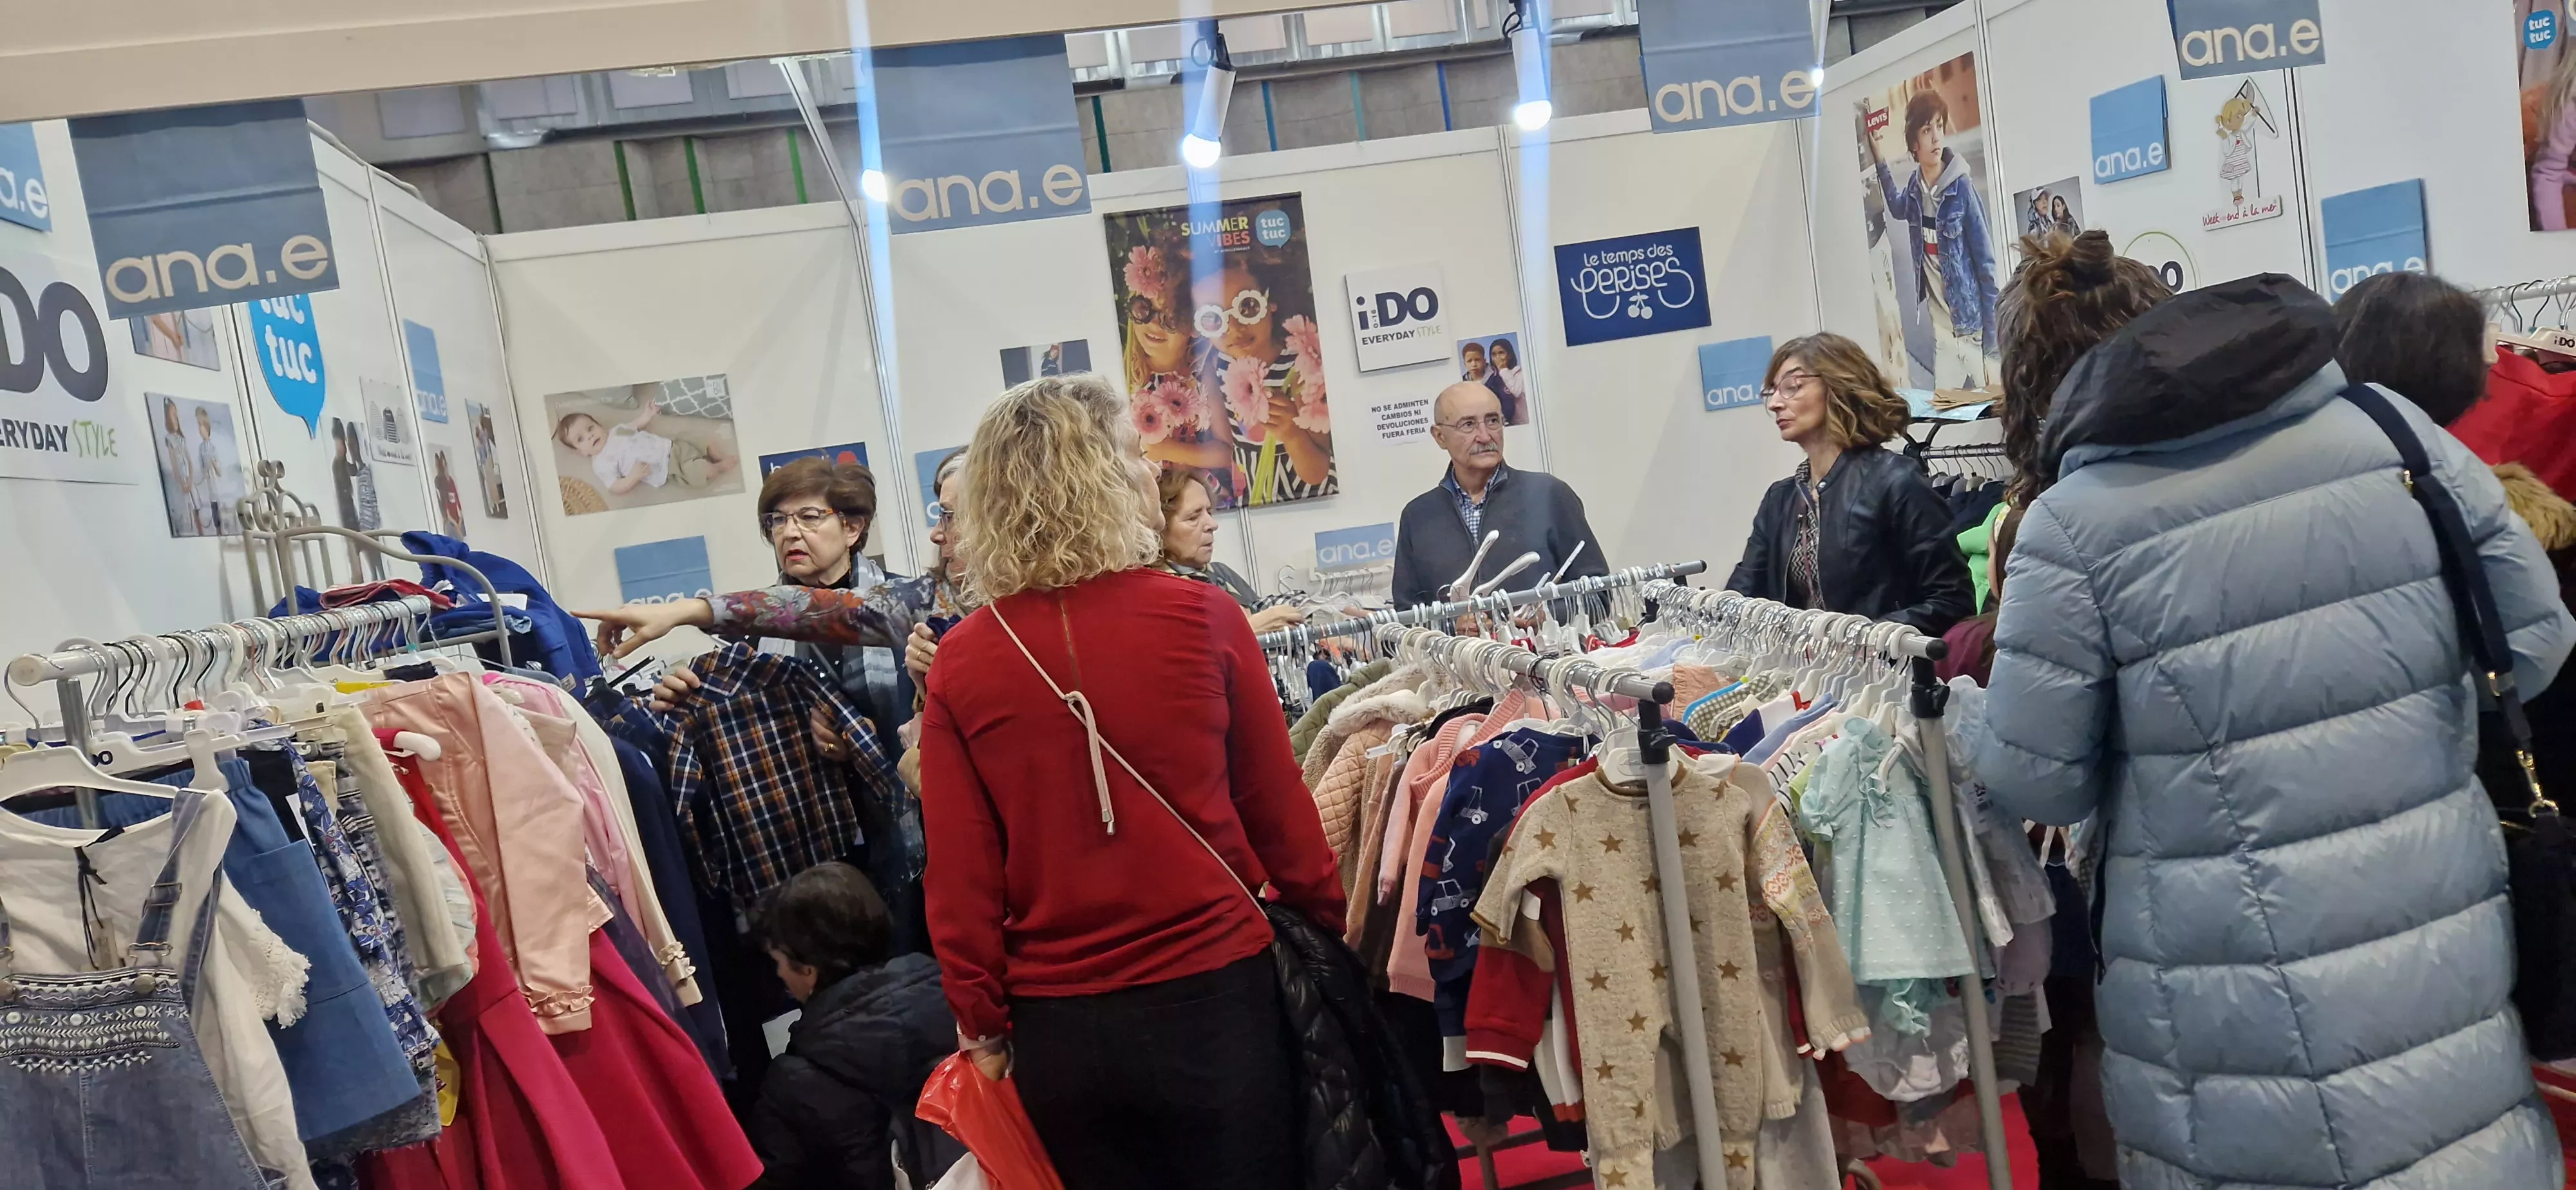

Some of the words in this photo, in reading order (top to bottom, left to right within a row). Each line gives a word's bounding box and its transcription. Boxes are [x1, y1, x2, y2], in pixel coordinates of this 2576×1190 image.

[2528, 17, 2550, 31] tuc
[2182, 19, 2320, 66] ana.e
[2529, 30, 2551, 43] tuc
[1655, 70, 1815, 122] ana.e
[2095, 142, 2163, 178] ana.e
[893, 164, 1083, 222] ana.e
[1180, 216, 1249, 236] SUMMER
[1260, 218, 1284, 228] tuc
[1207, 231, 1251, 247] VIBES
[1262, 229, 1286, 240] tuc
[1601, 248, 1645, 264] temps
[1647, 243, 1673, 258] des
[105, 234, 328, 303] ana.e
[1362, 330, 1416, 345] EVERYDAY
[1417, 325, 1442, 337] STYLE
[265, 324, 317, 384] tuc
[1377, 417, 1429, 431] DEVOLUCIONES
[1381, 410, 1412, 420] CAMBIOS
[73, 419, 118, 458] STYLE
[1382, 430, 1405, 439] FUERA
[1406, 427, 1426, 435] FERIA
[1320, 538, 1394, 563] ana.e
